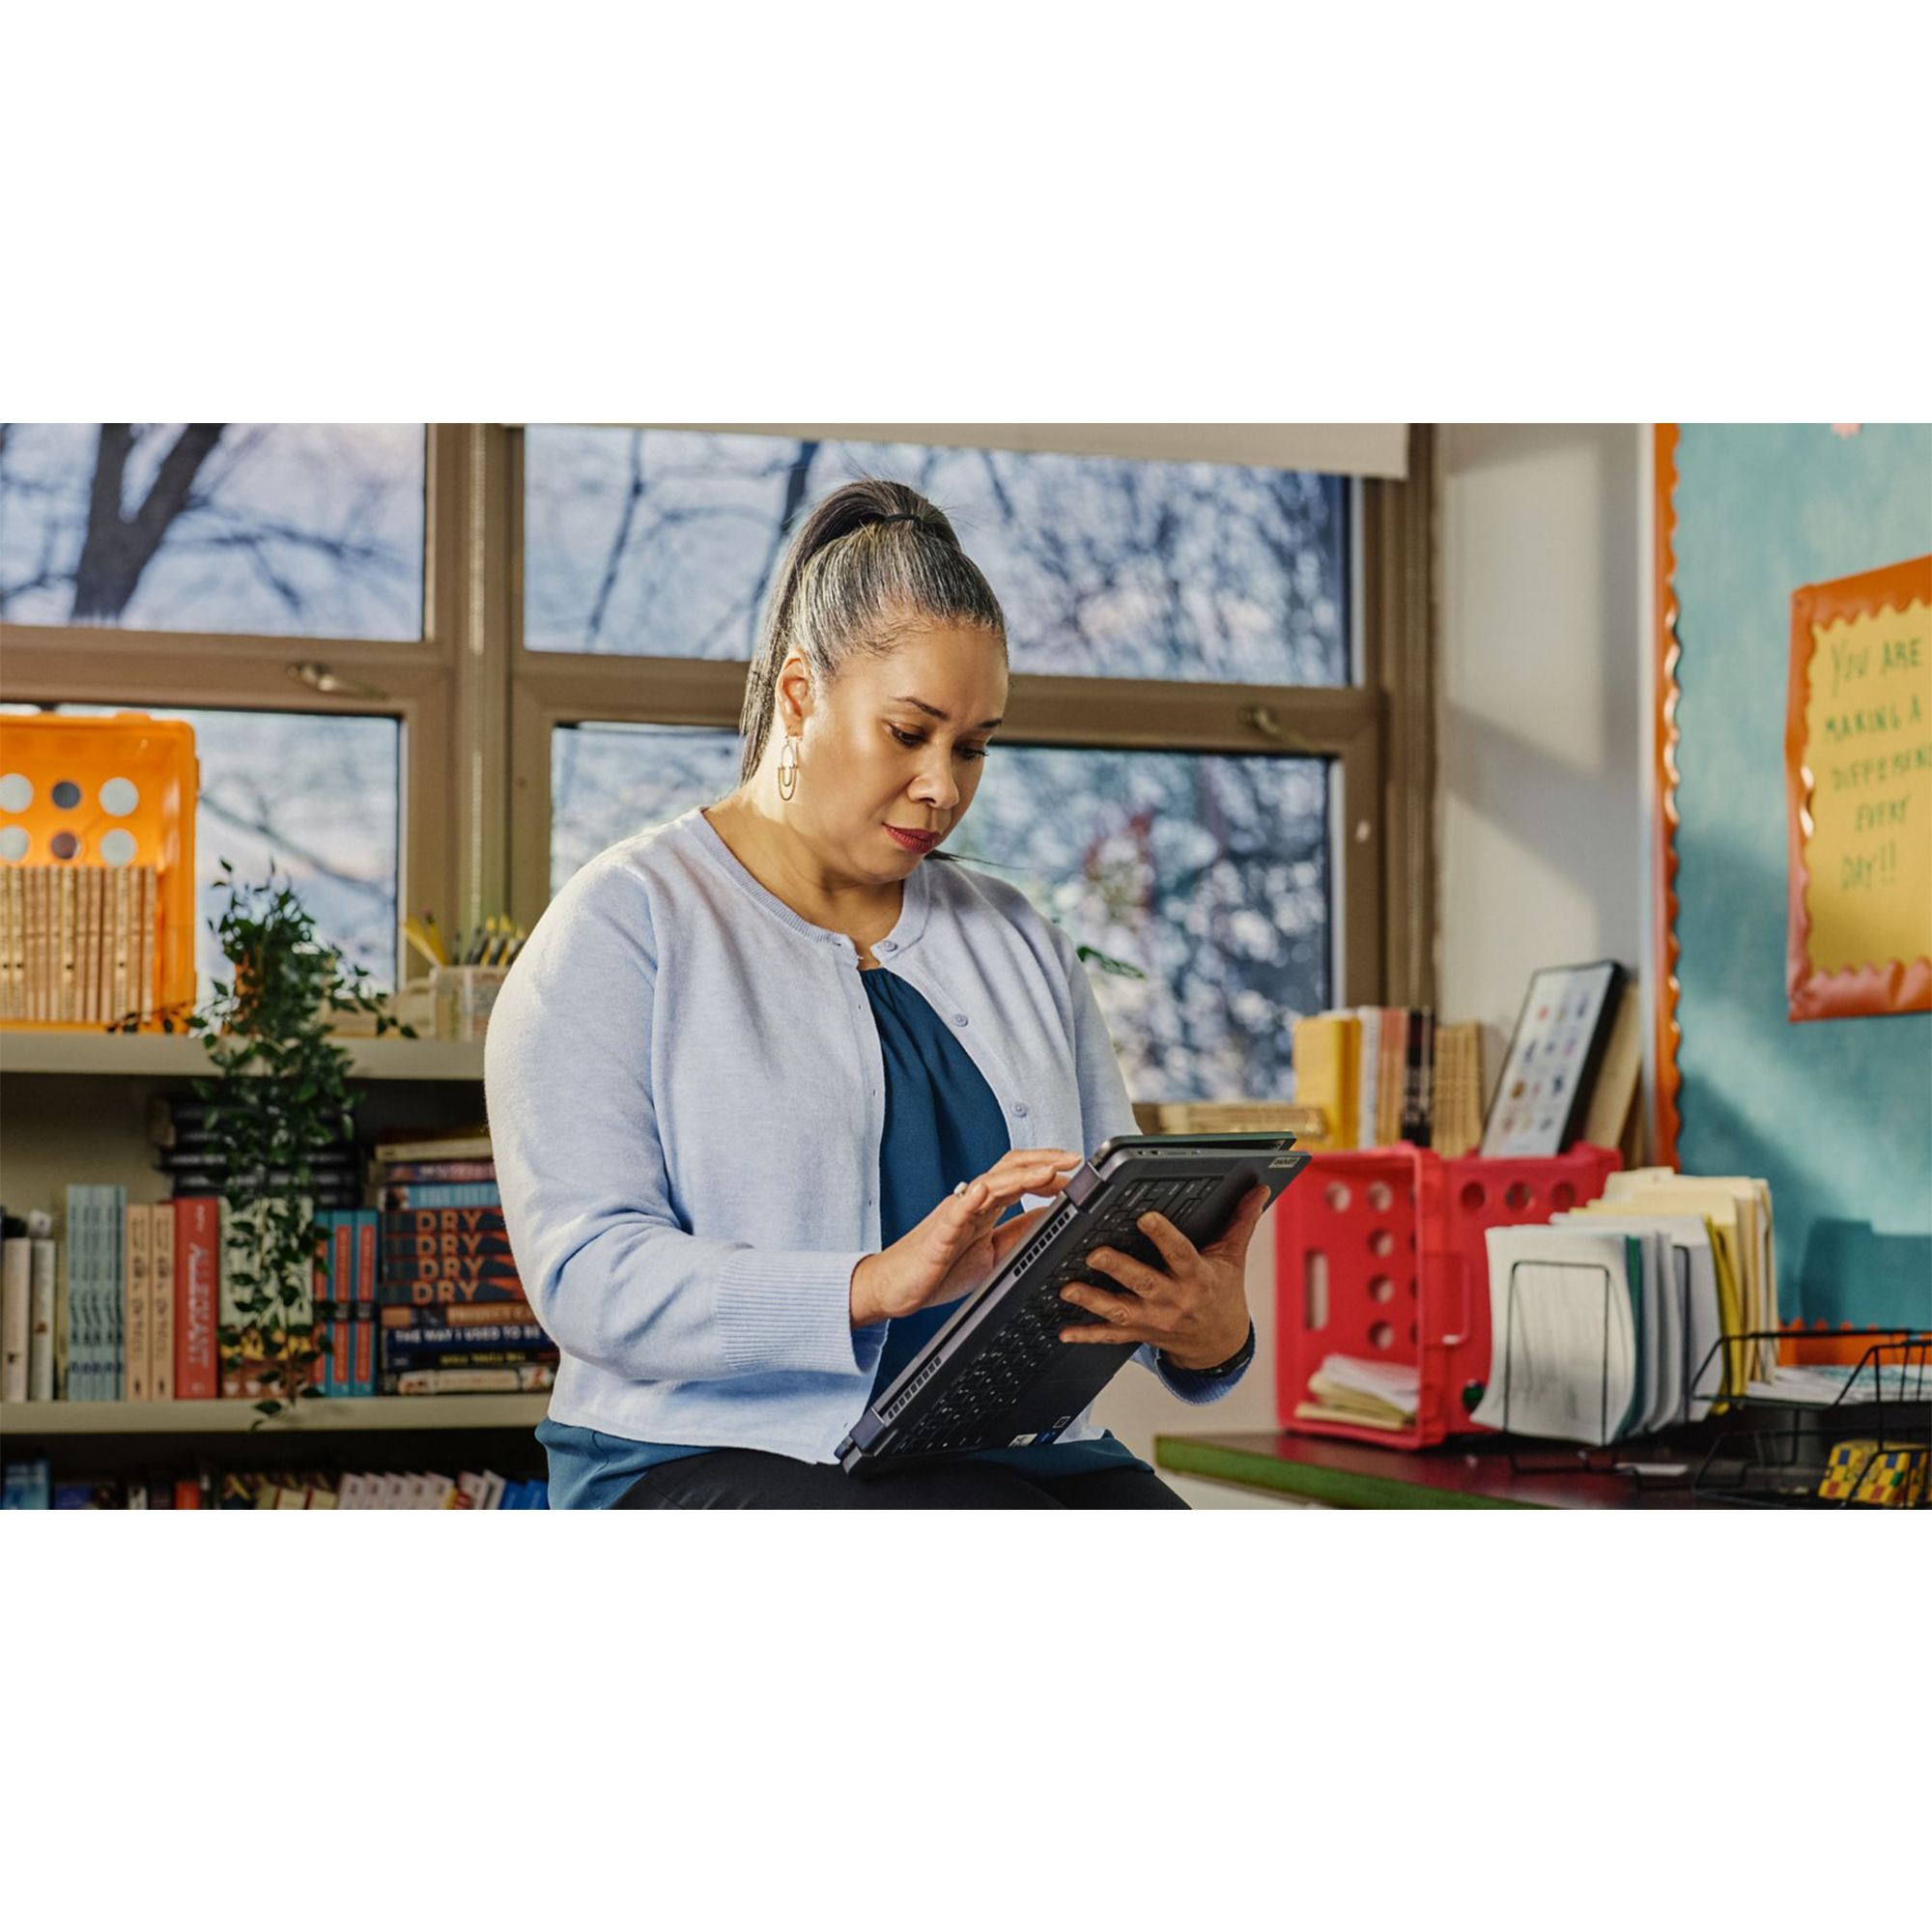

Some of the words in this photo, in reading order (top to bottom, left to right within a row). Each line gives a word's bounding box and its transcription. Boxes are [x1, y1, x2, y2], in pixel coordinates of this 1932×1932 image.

[1880, 636, 1922, 676] ARE
[1823, 703, 1901, 744] MAKING
[1908, 693, 1922, 725] A
[1856, 792, 1912, 833] EVERY
[416, 1210, 482, 1232] DRY
[416, 1234, 482, 1256] DRY
[418, 1257, 484, 1281] DRY
[412, 1280, 479, 1305] DRY
[395, 1329, 422, 1344] THE
[424, 1327, 452, 1343] WAY
[455, 1328, 463, 1342] I
[466, 1326, 500, 1341] USED
[503, 1325, 521, 1339] TO
[524, 1324, 541, 1339] BE
